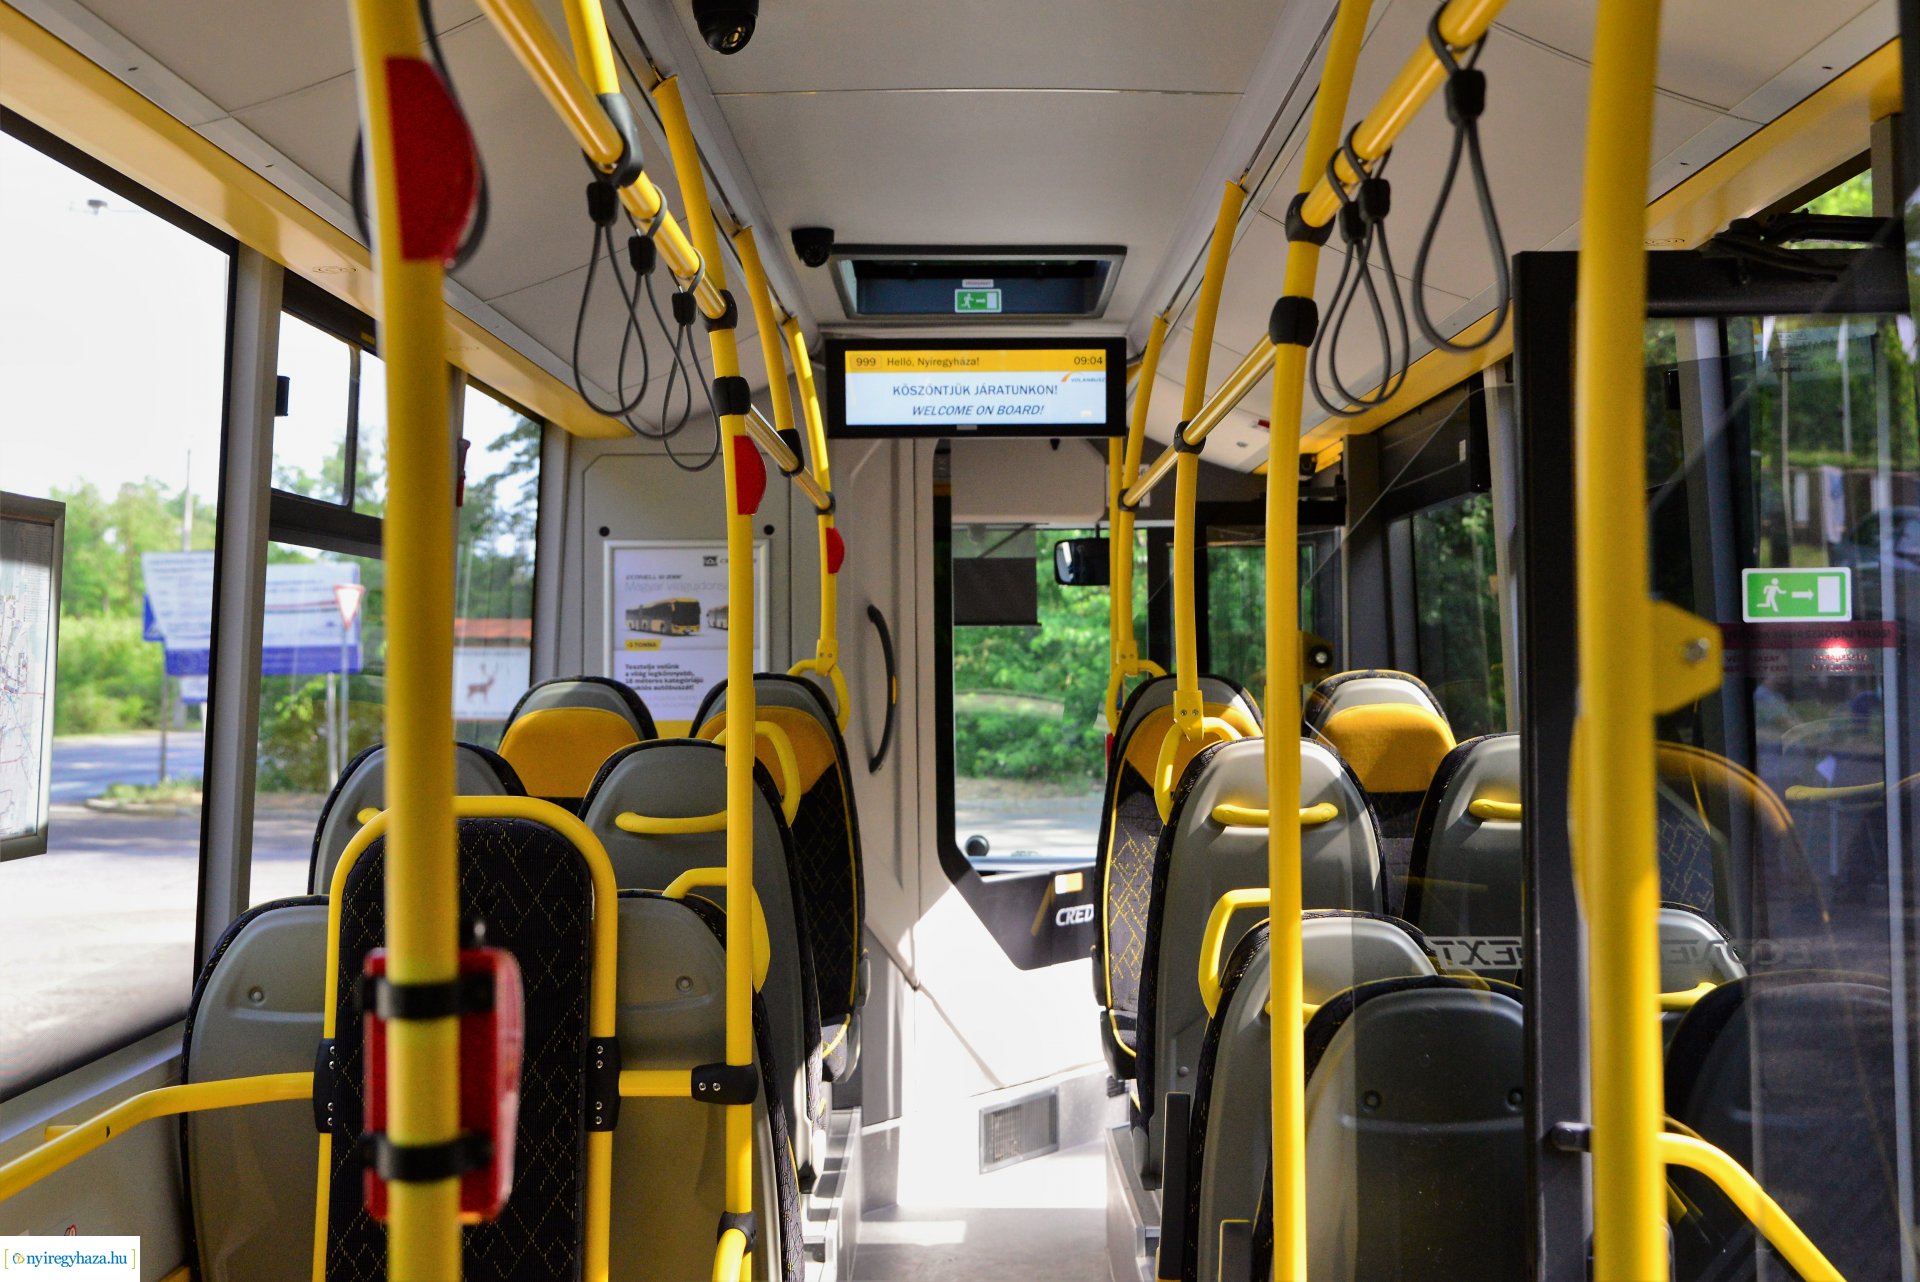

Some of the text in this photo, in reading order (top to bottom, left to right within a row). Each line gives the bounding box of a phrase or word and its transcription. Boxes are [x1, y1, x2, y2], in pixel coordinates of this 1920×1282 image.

[856, 357, 980, 369] 999 Helló, Nyíregyháza!
[1073, 355, 1103, 366] 09:04
[893, 382, 1058, 397] KÖSZÖNTJÜK JÁRATUNKON!
[912, 404, 1045, 416] WELCOME ON BOARD!
[1056, 904, 1094, 926] CRED
